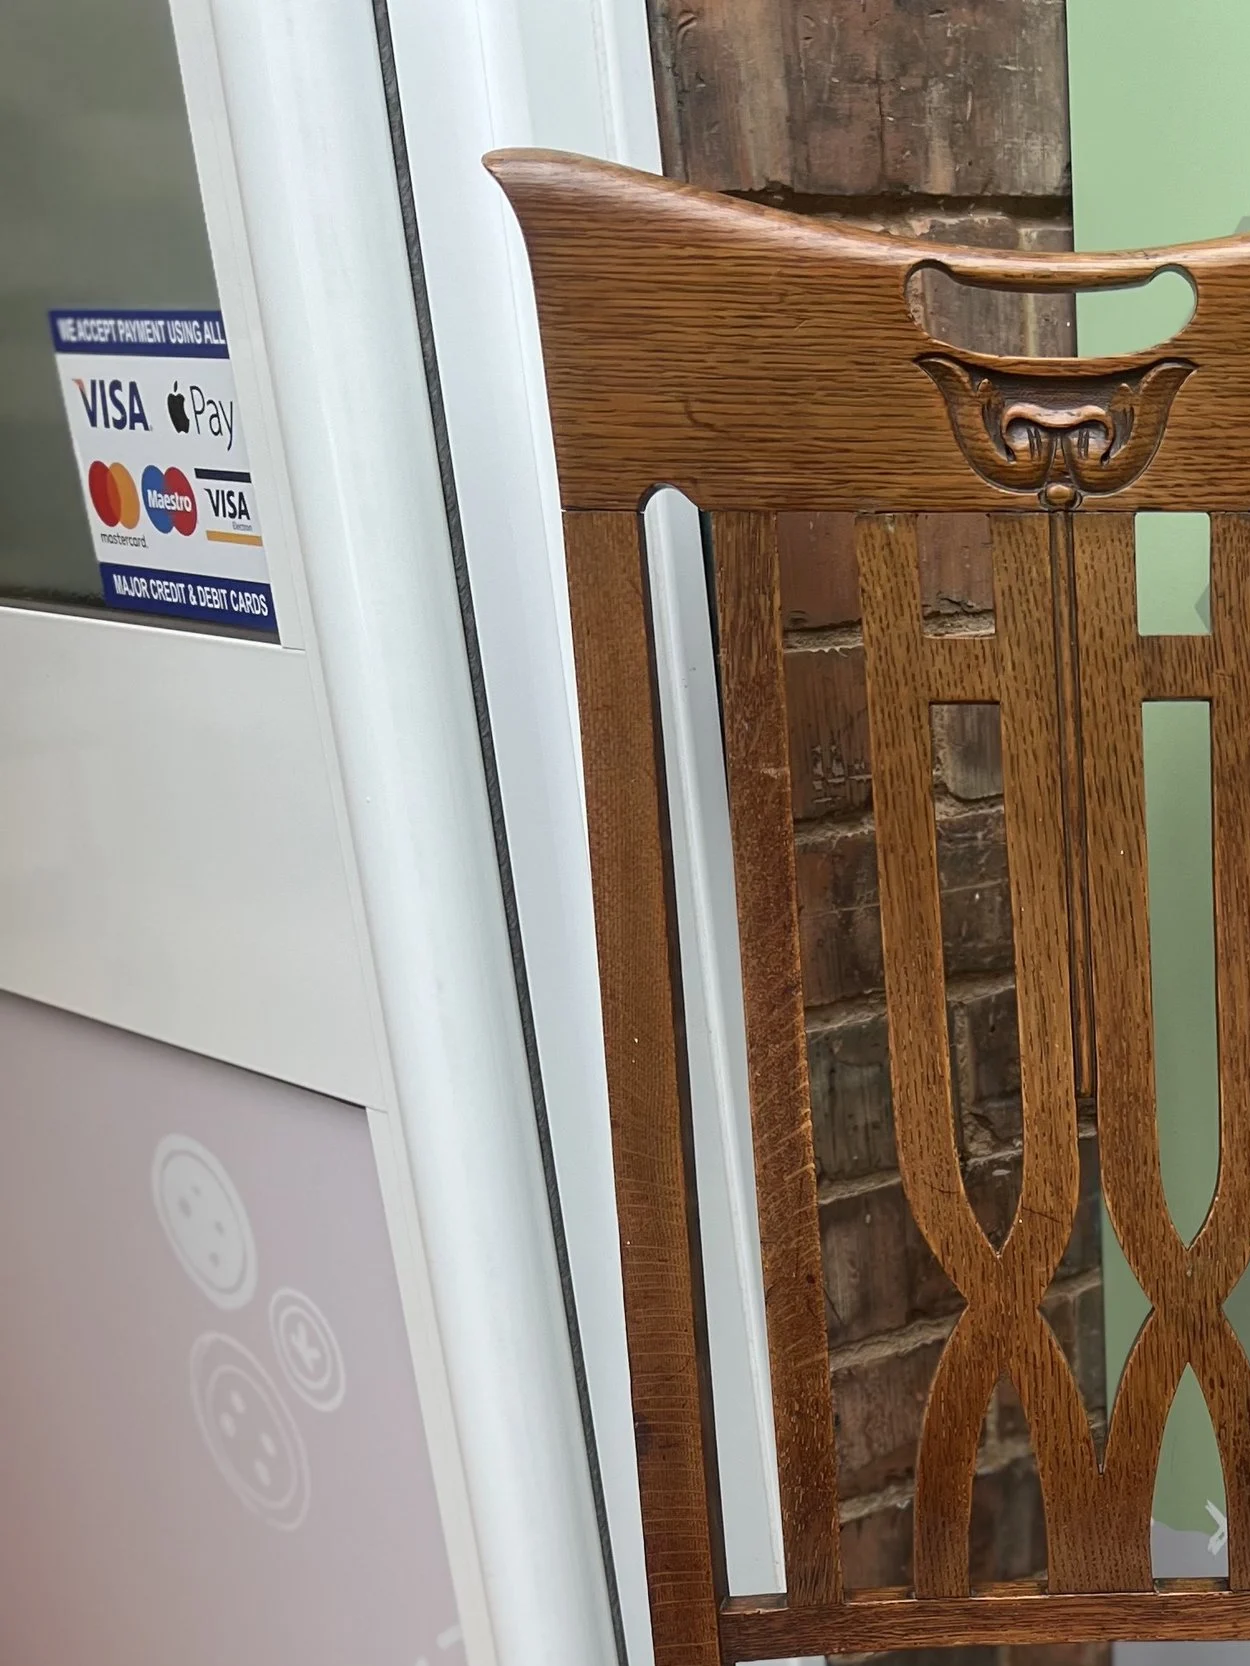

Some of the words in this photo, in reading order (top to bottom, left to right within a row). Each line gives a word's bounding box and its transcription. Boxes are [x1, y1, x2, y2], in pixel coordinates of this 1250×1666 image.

[57, 318, 77, 342] WE
[76, 318, 117, 343] ACCEPT
[117, 320, 166, 344] PAYMENT
[167, 321, 202, 345] USING
[203, 321, 226, 345] ALL
[72, 378, 150, 432] VISA
[190, 386, 233, 450] Pay
[147, 489, 192, 513] Maestro
[203, 488, 251, 520] VISA
[100, 532, 149, 549] mastercard
[113, 575, 150, 599] MAJOR
[149, 578, 187, 604] CREDIT
[188, 584, 197, 605] &
[198, 586, 229, 611] DEBIT
[230, 591, 268, 616] CARDS
